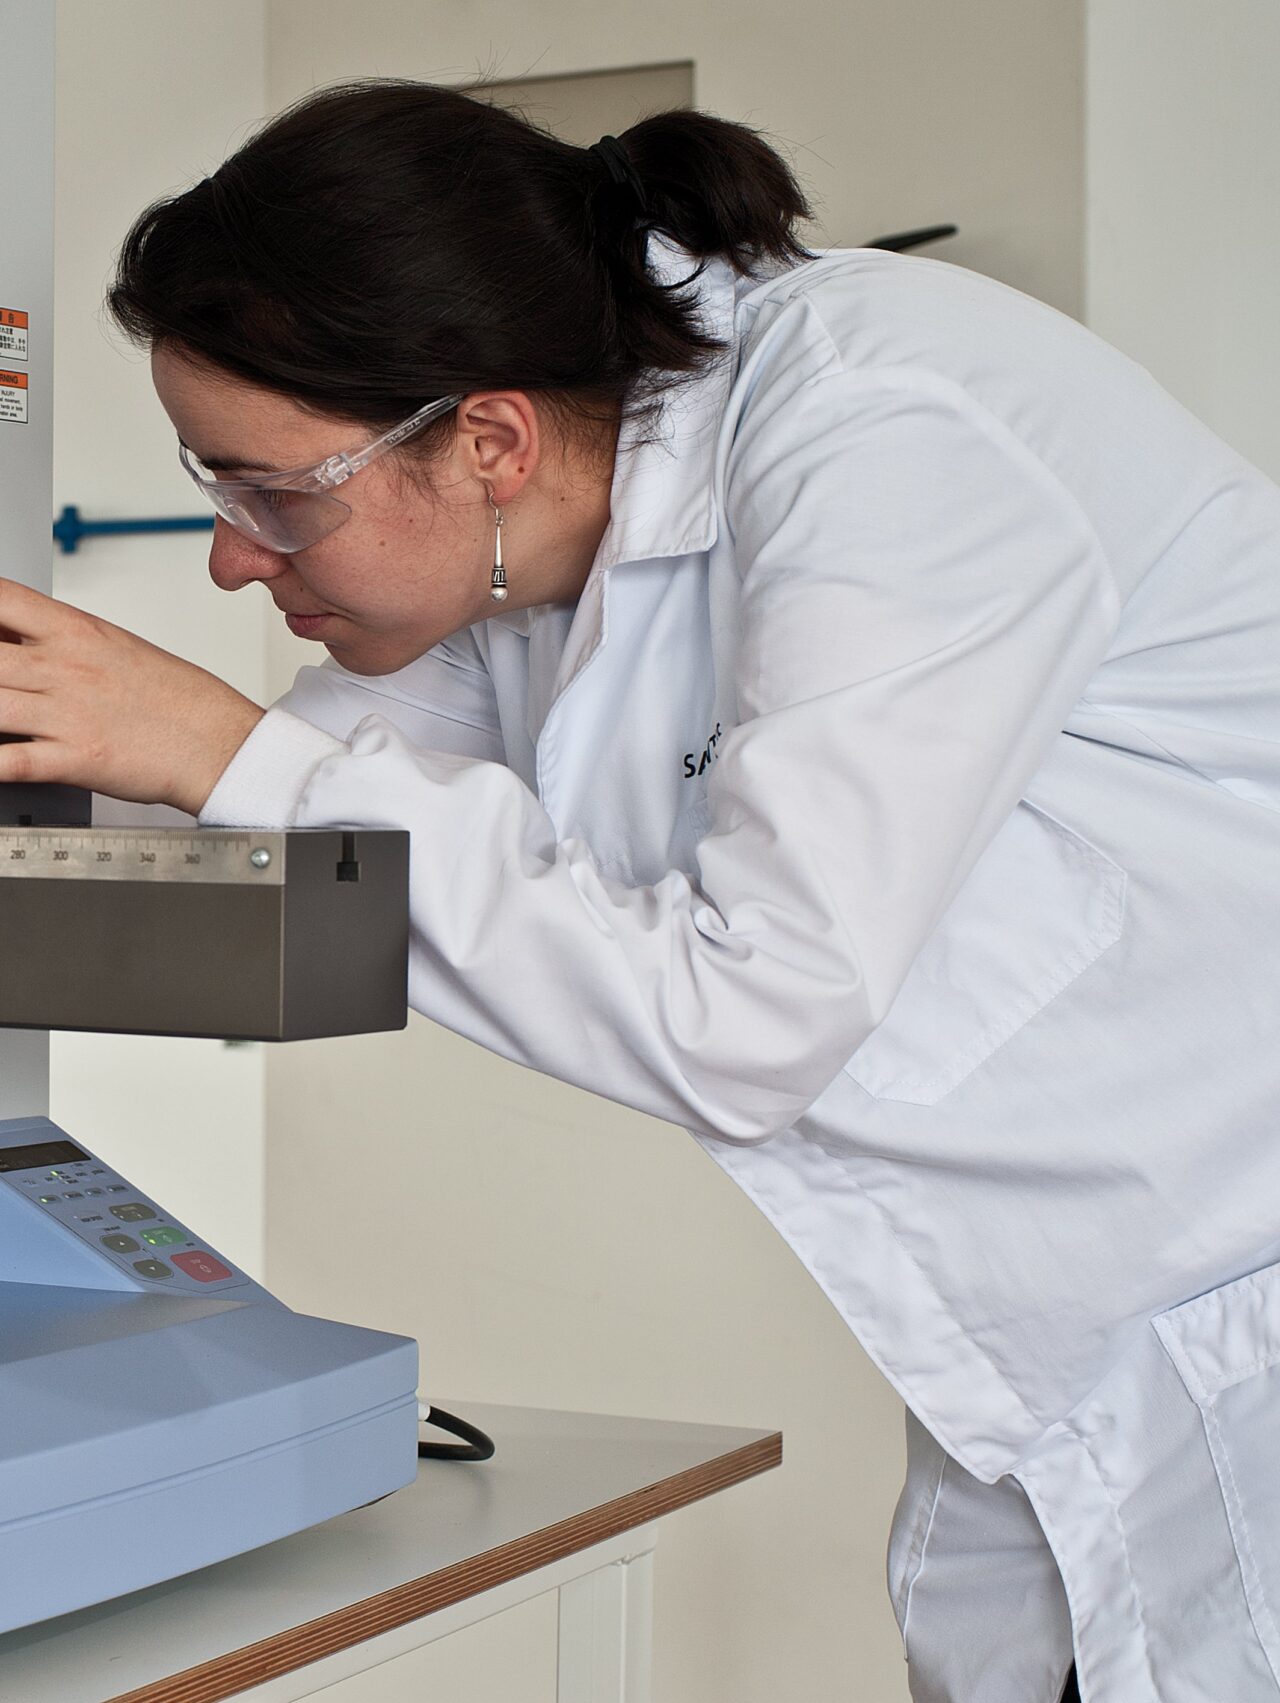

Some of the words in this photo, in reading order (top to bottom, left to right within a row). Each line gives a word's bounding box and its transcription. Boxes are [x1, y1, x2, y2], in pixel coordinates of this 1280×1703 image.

[10, 850, 26, 860] 280
[53, 851, 68, 861] 300
[96, 852, 112, 862] 320
[140, 853, 156, 863] 340
[184, 853, 200, 864] 360
